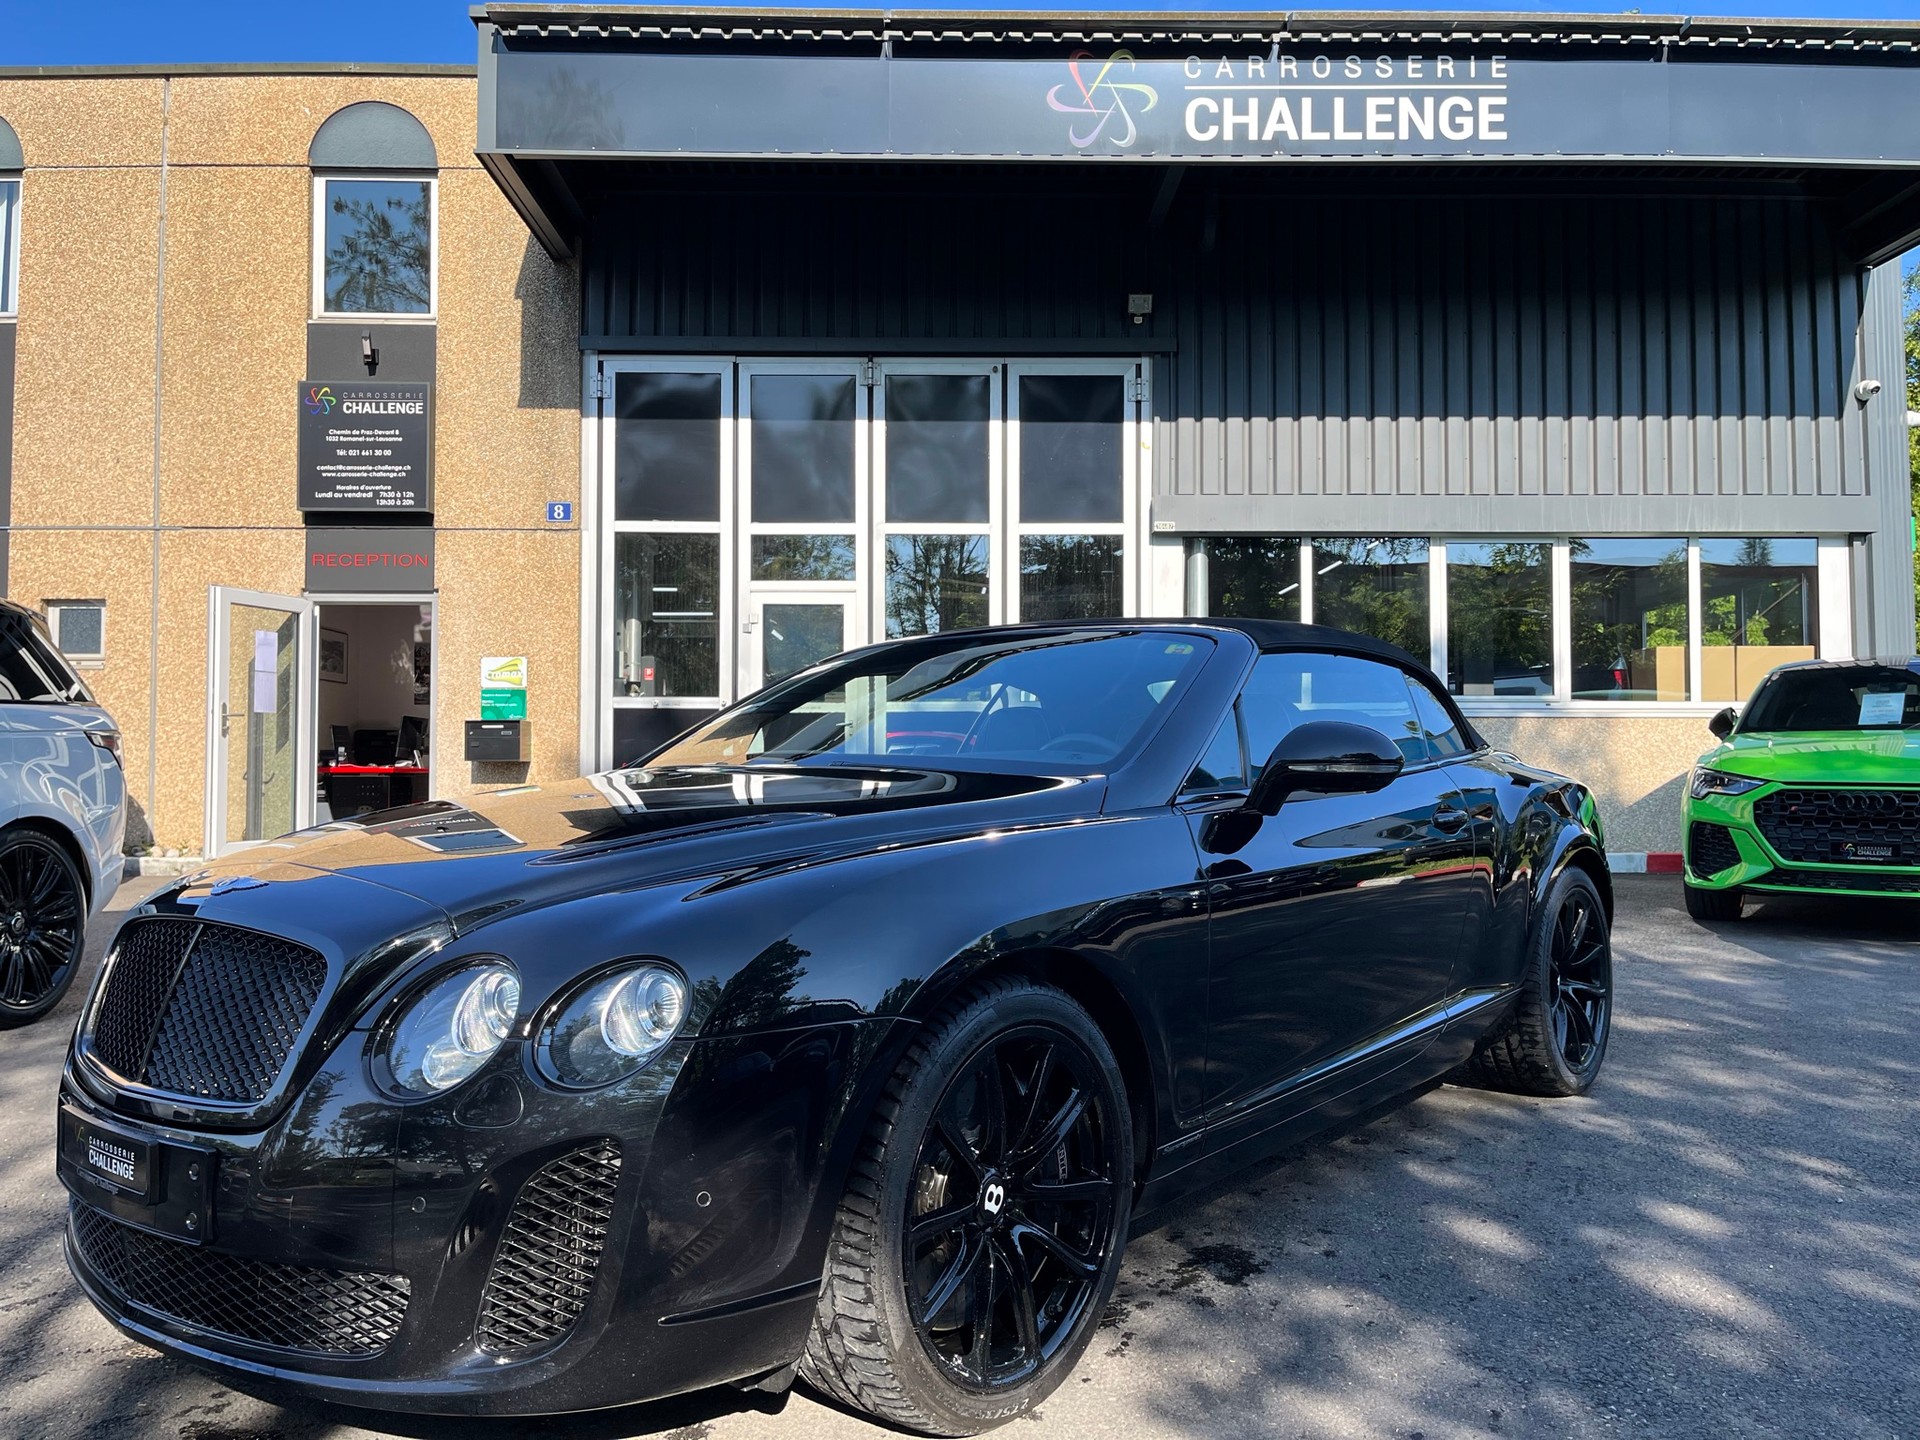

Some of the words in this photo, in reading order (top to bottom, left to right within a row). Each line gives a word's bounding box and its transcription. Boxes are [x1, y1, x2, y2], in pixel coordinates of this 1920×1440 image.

[1183, 55, 1508, 79] CARROSSERIE
[1184, 96, 1509, 141] CHALLENGE
[342, 391, 424, 399] CARROSSERIE
[342, 401, 424, 414] CHALLENGE
[336, 448, 348, 456] Tél:
[316, 464, 412, 472] contact@carrosserie-challenge.ch
[553, 504, 565, 519] 8
[311, 553, 429, 567] RECEPTION
[88, 1135, 135, 1161] CARROSSERIE
[88, 1148, 135, 1181] CHALLENGE
[984, 1183, 1004, 1215] B
